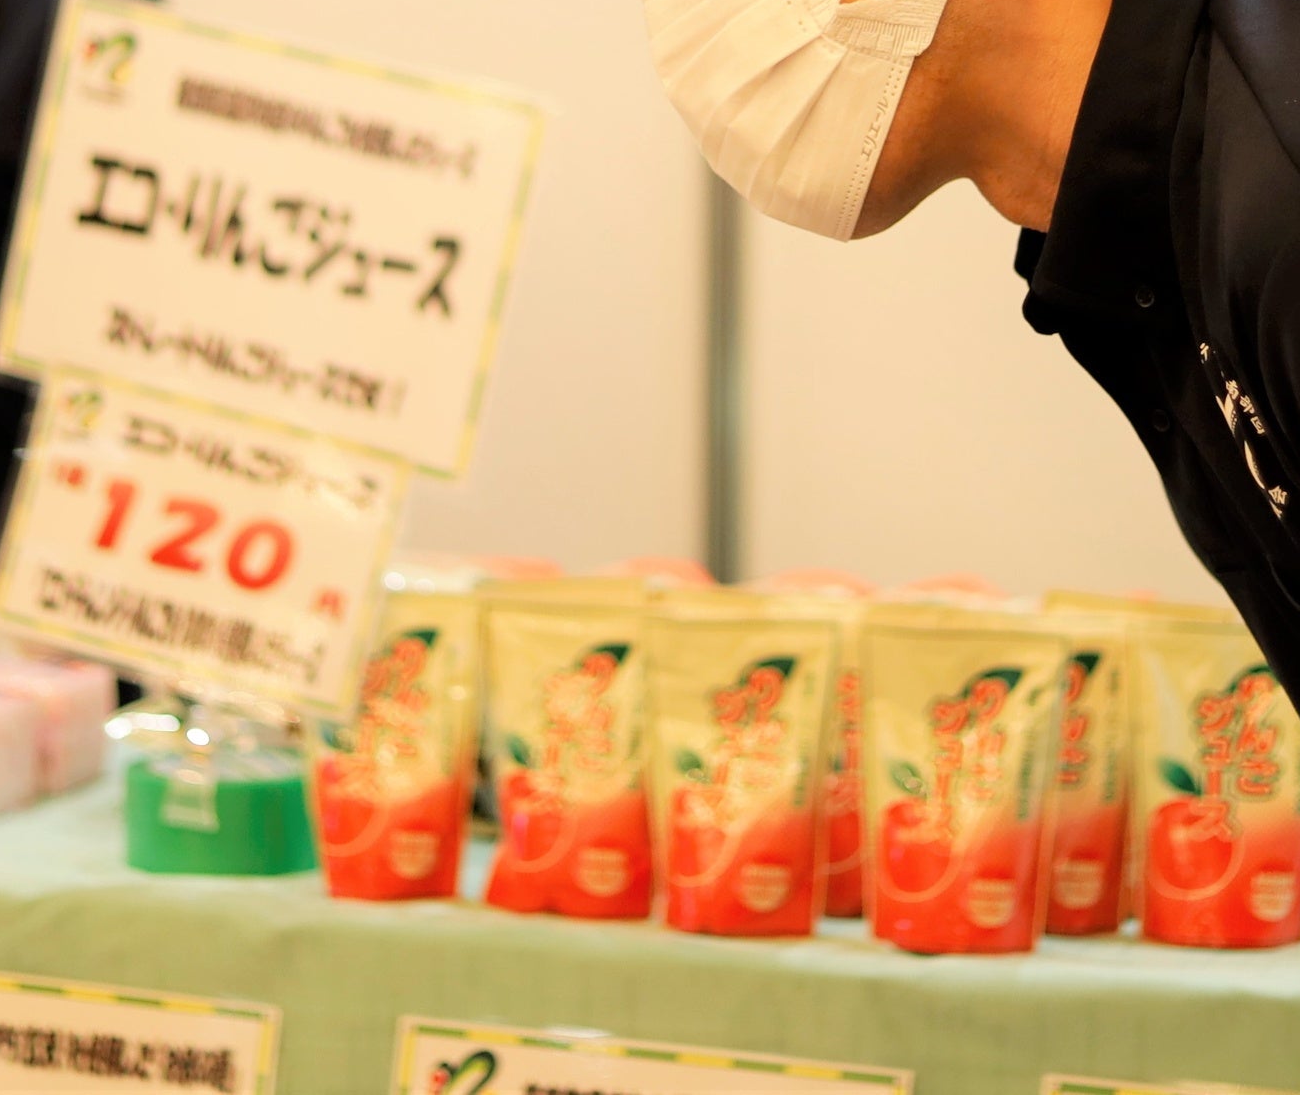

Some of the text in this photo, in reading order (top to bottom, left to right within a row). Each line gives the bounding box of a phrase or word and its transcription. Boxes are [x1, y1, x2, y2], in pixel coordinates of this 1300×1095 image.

[861, 96, 889, 162] エリエール
[93, 478, 297, 593] 120
